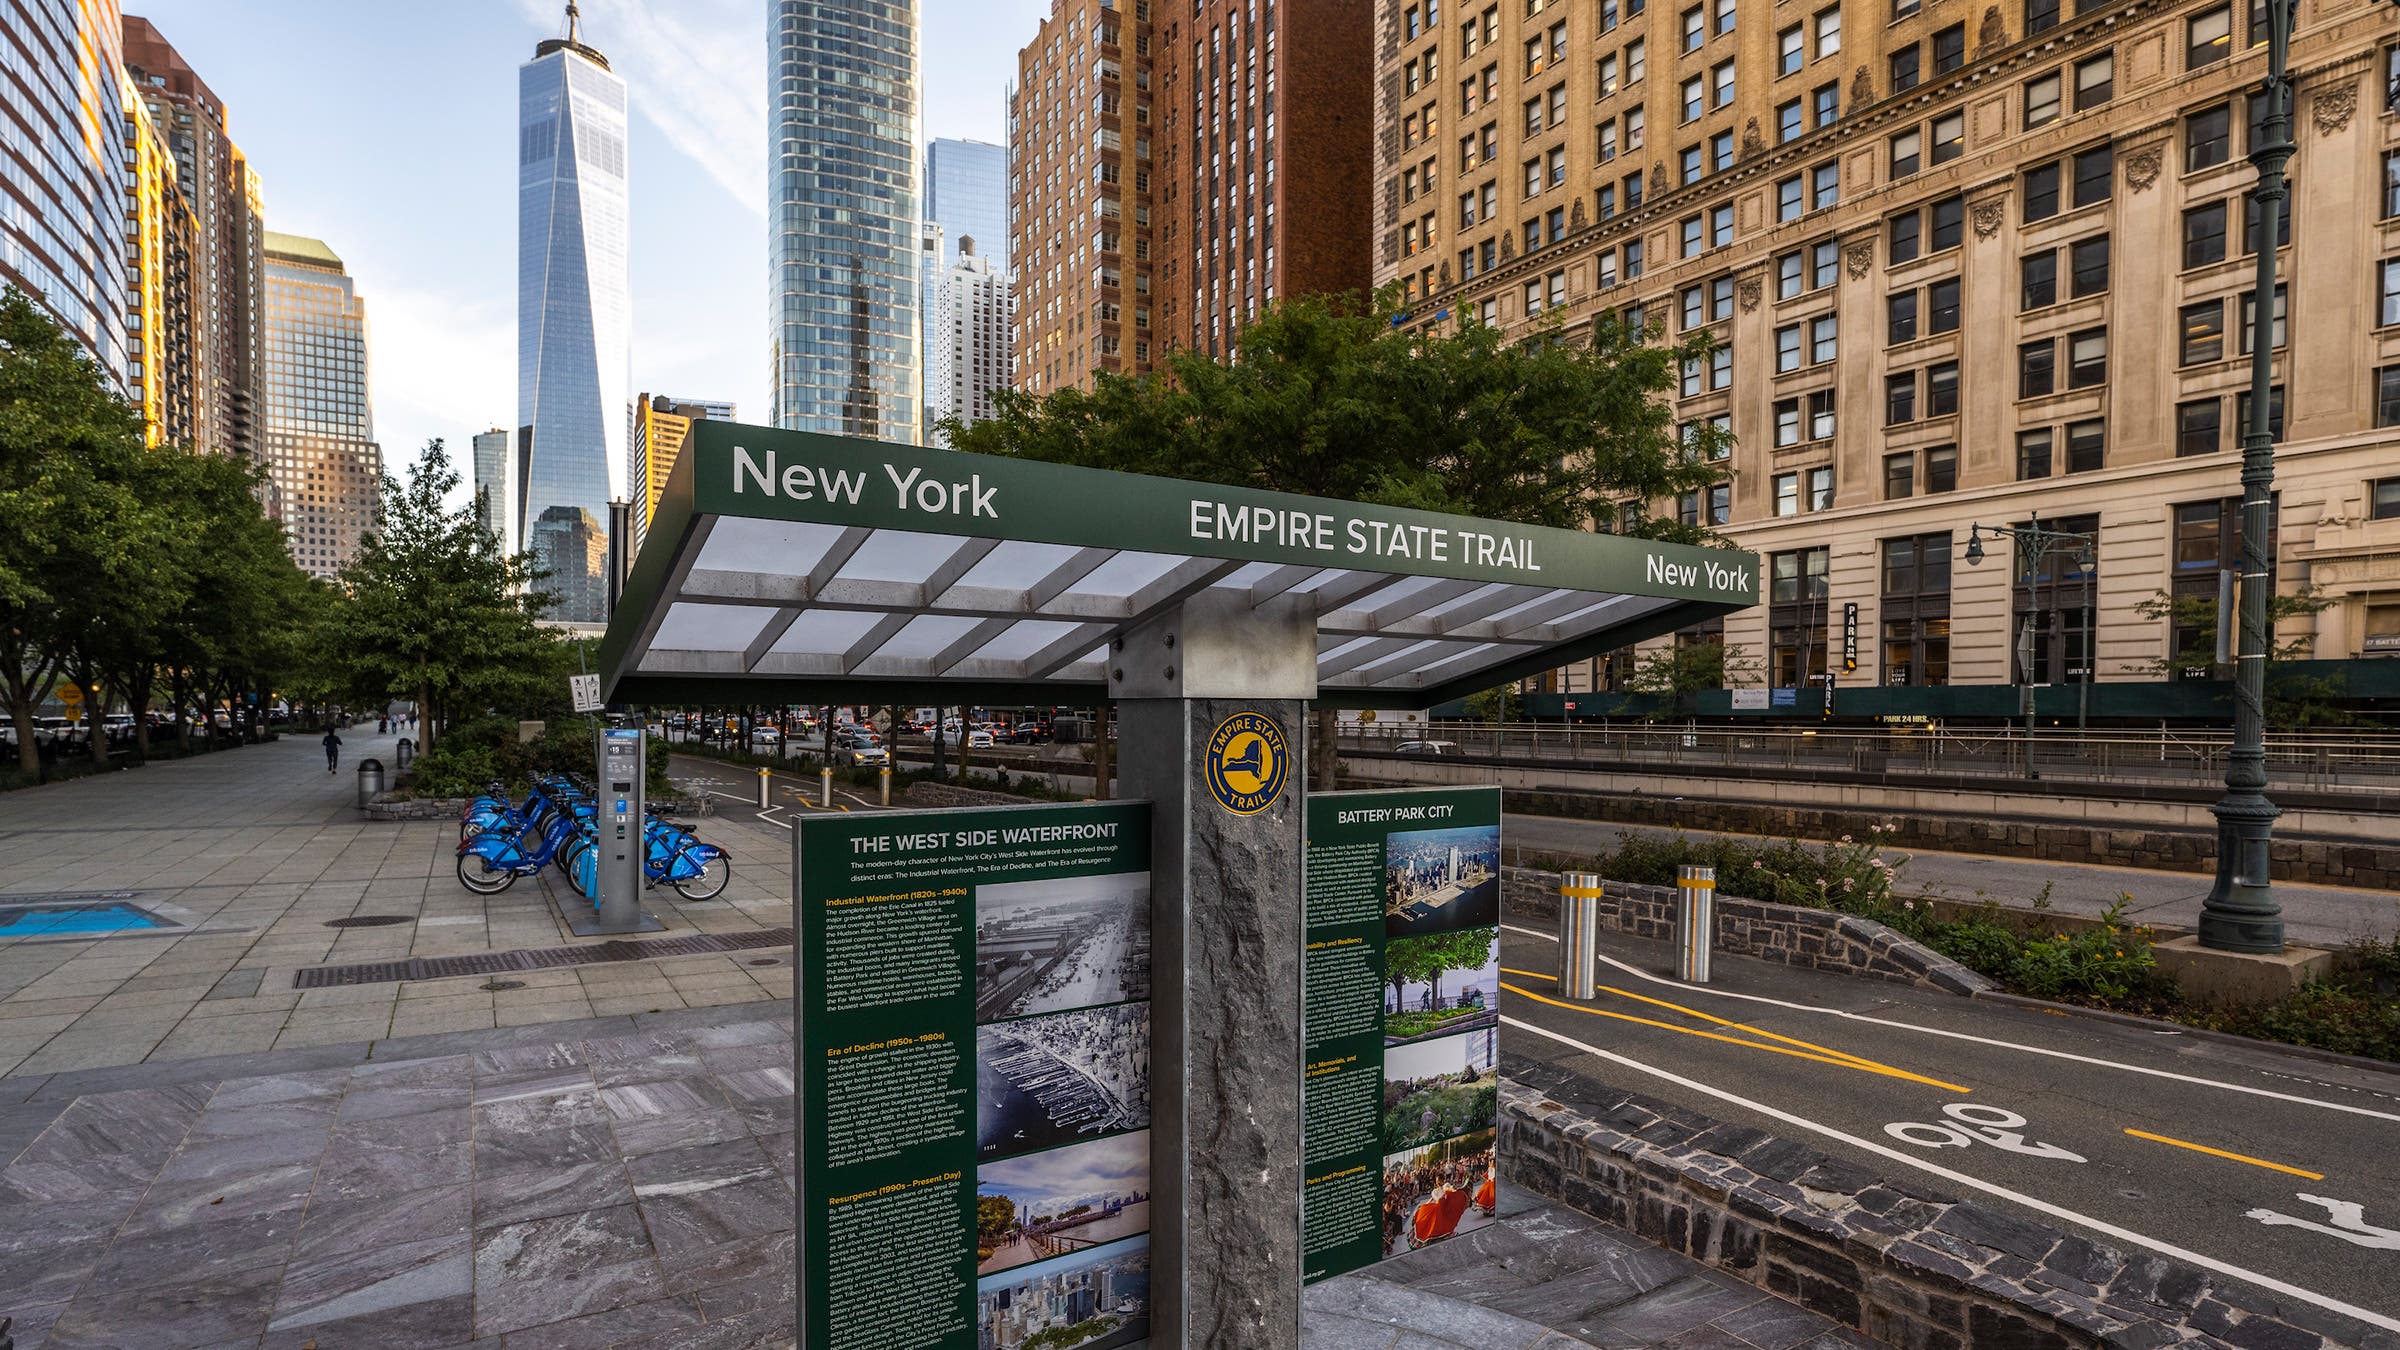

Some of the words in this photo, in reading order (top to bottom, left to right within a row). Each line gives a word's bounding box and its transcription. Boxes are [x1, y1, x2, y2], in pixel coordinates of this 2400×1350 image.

[734, 446, 866, 504] New
[884, 464, 998, 518] York
[1191, 500, 1334, 550] EMPIRE
[1347, 519, 1447, 561] STATE
[1458, 532, 1540, 570] TRAIL
[1647, 554, 1697, 586] New
[1704, 561, 1748, 592] York
[1848, 606, 1856, 646] PARK
[1213, 718, 1251, 754] EMPIRE
[1254, 720, 1283, 754] STATE
[1230, 793, 1267, 809] TRAIL
[1339, 809, 1392, 823] BATTERY
[1395, 807, 1425, 820] PARK
[1428, 805, 1453, 818] CITY
[850, 836, 890, 853] THE
[896, 833, 950, 850] WEST
[956, 830, 997, 846] SIDE
[1002, 823, 1118, 843] WATERFRONT
[865, 858, 906, 867] modern-day
[980, 852, 998, 860] City's
[1030, 847, 1060, 855] Waterfront
[1096, 843, 1118, 852] through
[909, 869, 939, 877] Industrial
[941, 866, 975, 875] Waterfront,
